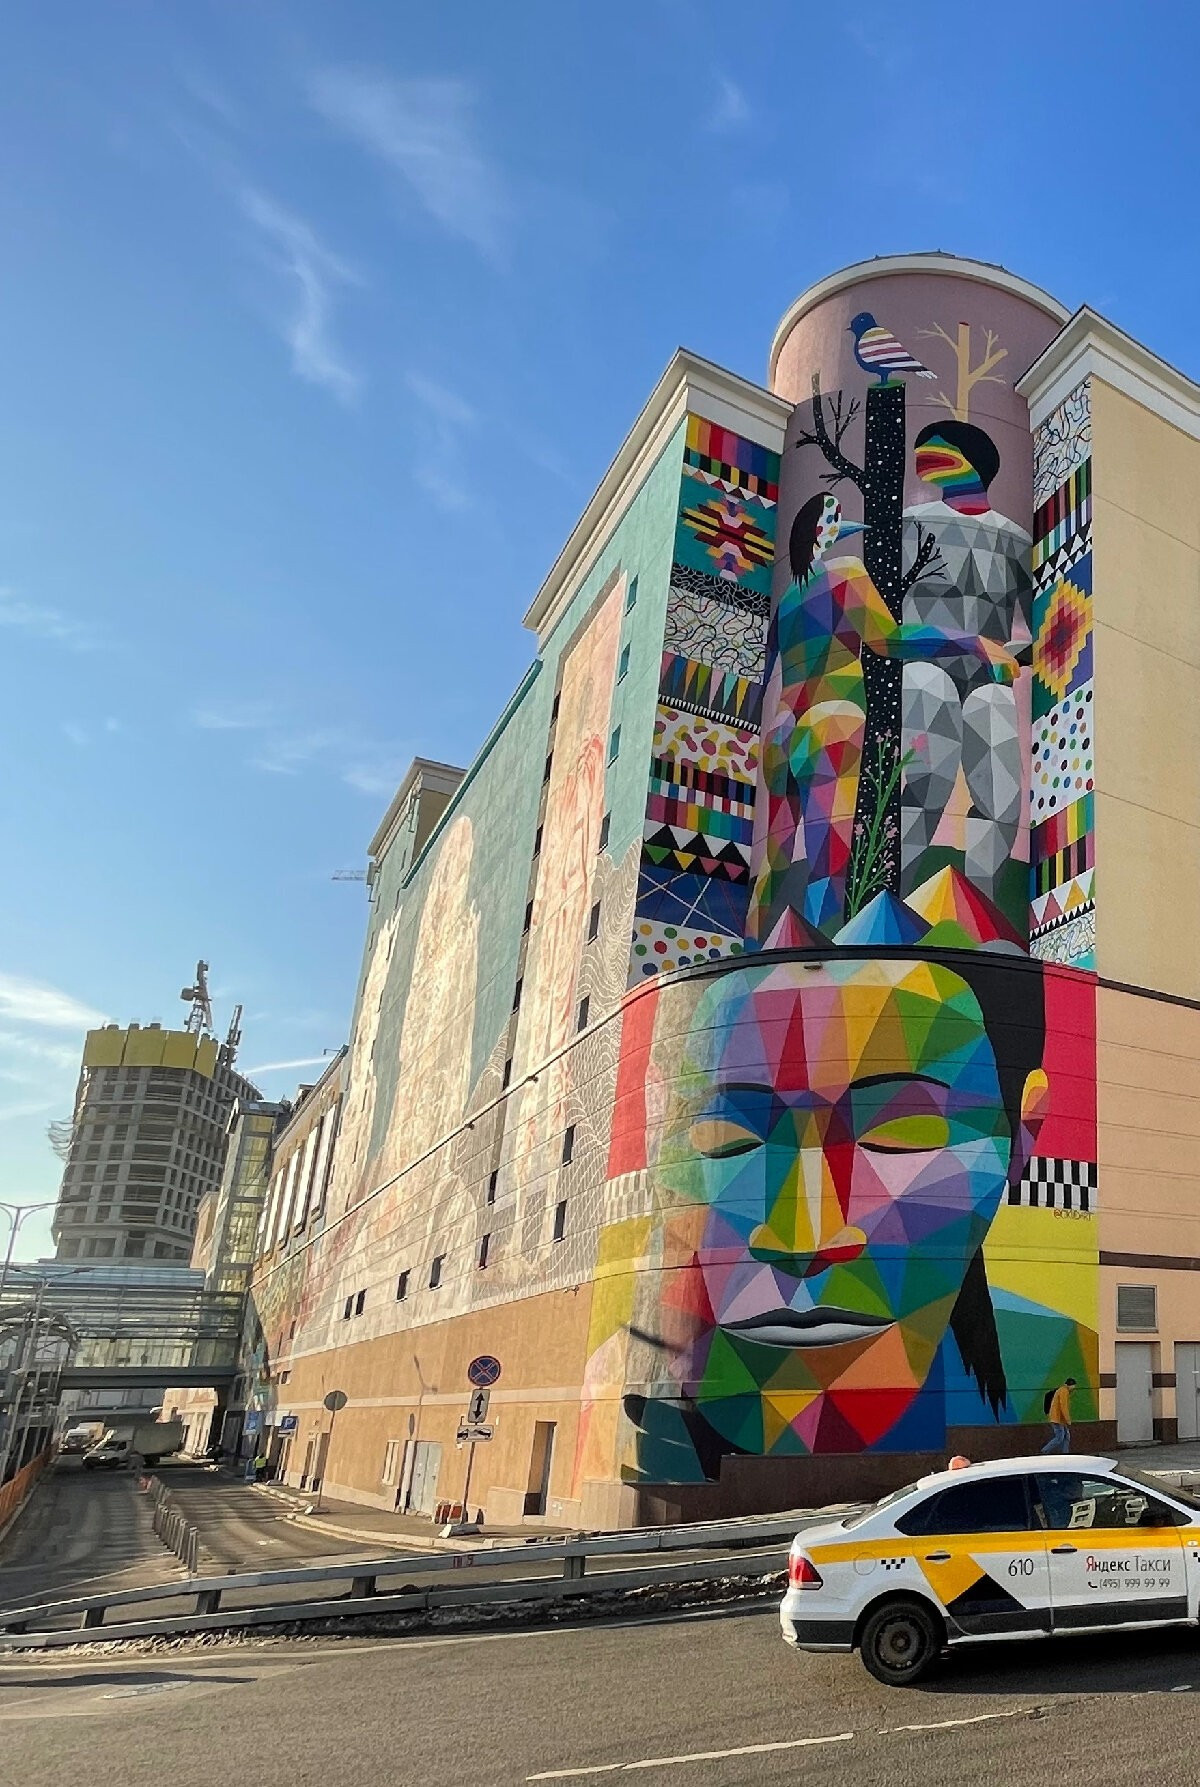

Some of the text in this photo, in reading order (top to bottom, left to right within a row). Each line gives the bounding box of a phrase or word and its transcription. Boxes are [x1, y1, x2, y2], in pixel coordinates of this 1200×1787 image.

[1008, 1558, 1034, 1577] 610
[1086, 1554, 1171, 1573] Яндекс Такси
[1099, 1577, 1171, 1590] (495) 999 99 99
